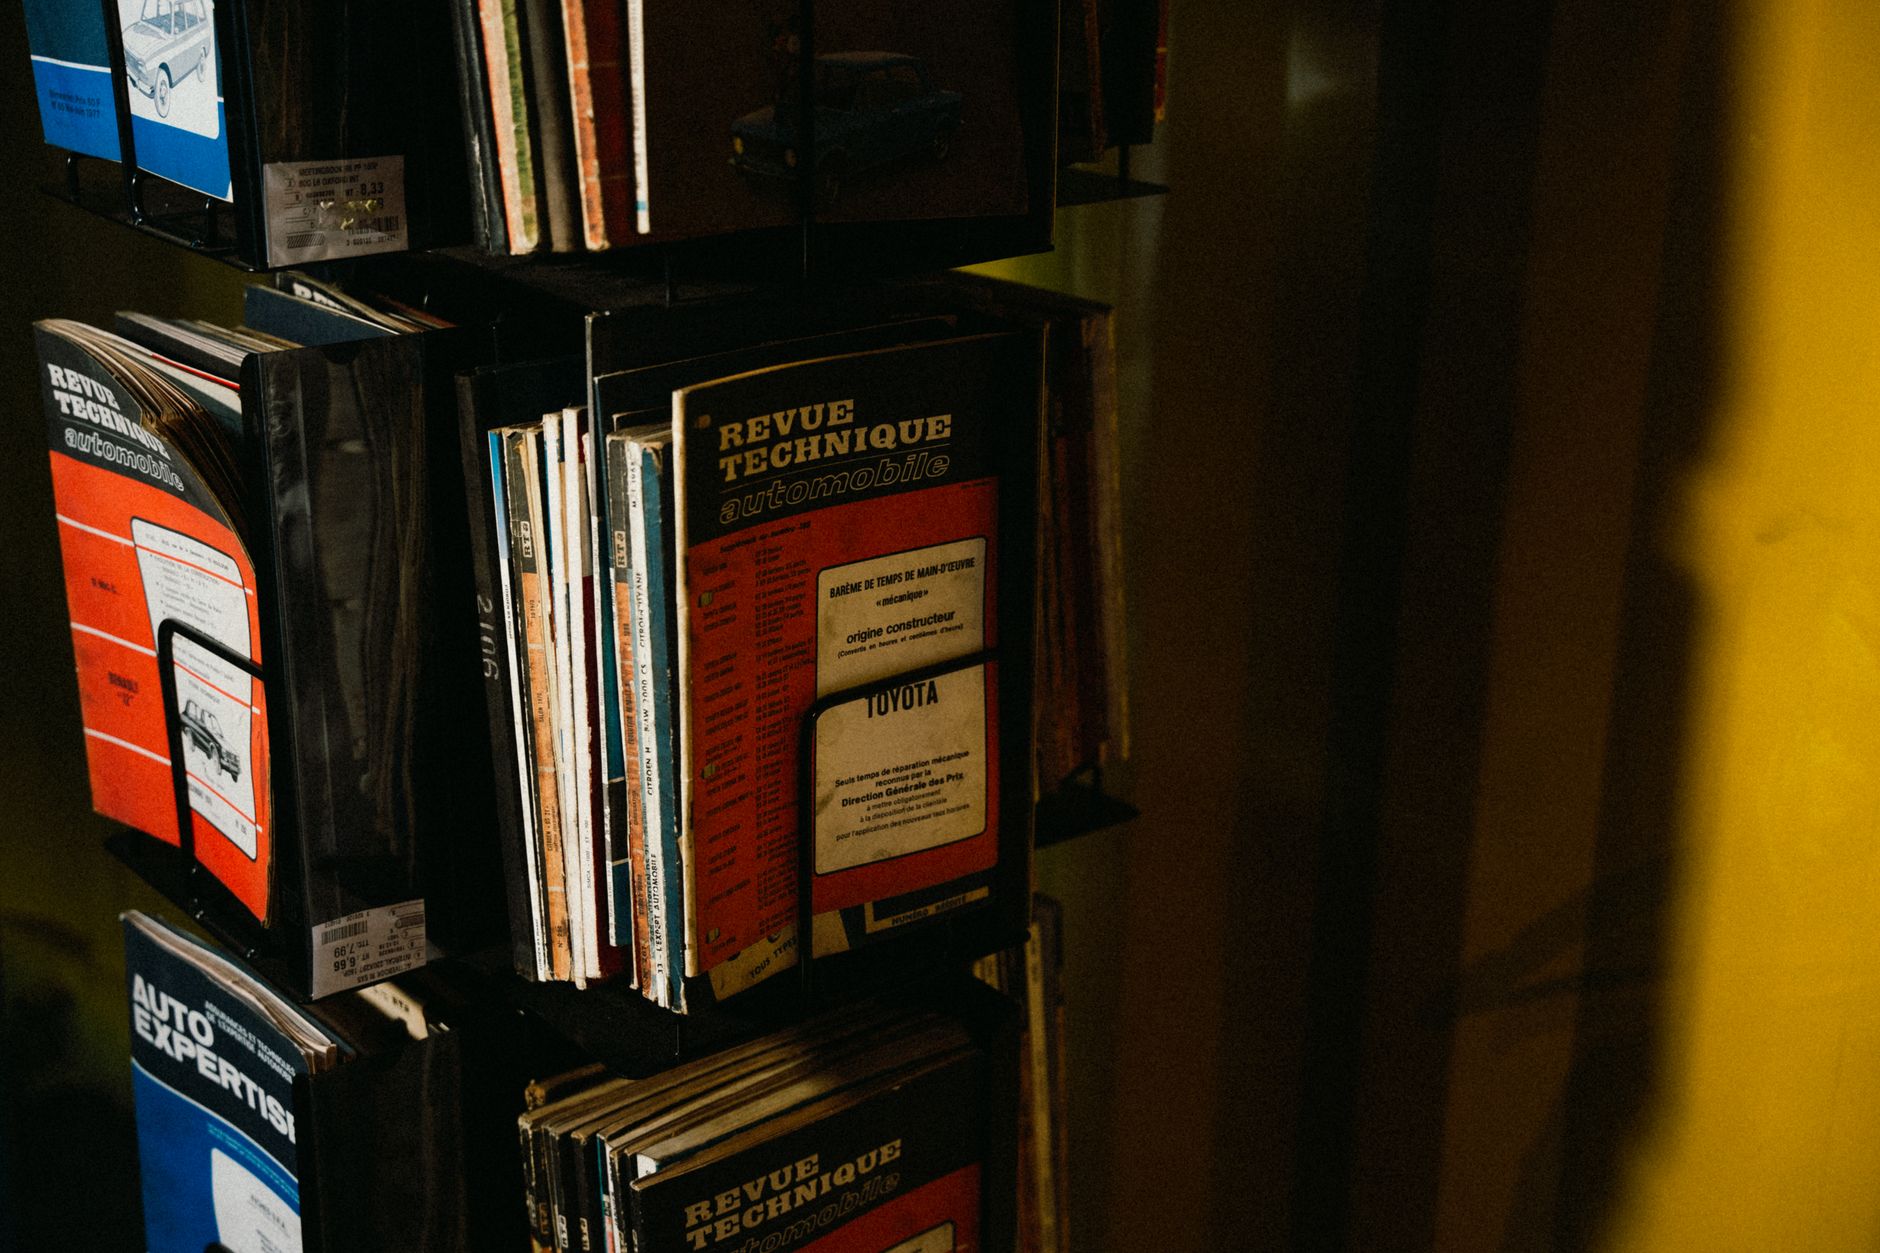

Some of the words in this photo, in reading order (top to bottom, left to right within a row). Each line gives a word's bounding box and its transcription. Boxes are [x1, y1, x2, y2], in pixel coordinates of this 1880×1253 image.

[360, 182, 384, 197] 8,33
[47, 363, 120, 411] REVUE
[53, 390, 171, 461] TECHNIQUE
[719, 399, 854, 451] REVUE
[719, 413, 952, 482] TECHNIQUE
[64, 428, 184, 491] automobile
[719, 452, 951, 525] automobile
[829, 581, 862, 599] BARÈME
[864, 579, 874, 590] DE
[876, 573, 903, 588] TEMPS
[905, 569, 915, 581] DE
[846, 626, 883, 644] origine
[886, 610, 955, 635] constructeur
[864, 680, 939, 718] TOYOTA
[835, 777, 856, 788] Seuls
[856, 771, 880, 783] temps
[881, 767, 890, 776] de
[892, 759, 930, 774] réparation
[931, 750, 970, 765] mécanique
[841, 790, 884, 807] Direction
[885, 781, 927, 797] Générale
[928, 777, 945, 787] des
[946, 771, 965, 783] Prix
[875, 775, 909, 788] reconnus
[911, 772, 923, 782] par
[334, 943, 355, 958] 7,99
[334, 957, 356, 972] 6,66
[133, 973, 214, 1047] AUTO
[684, 1152, 820, 1228] REVUE
[685, 1138, 903, 1251] TECHNIQUE
[733, 1171, 901, 1253] tomobile
